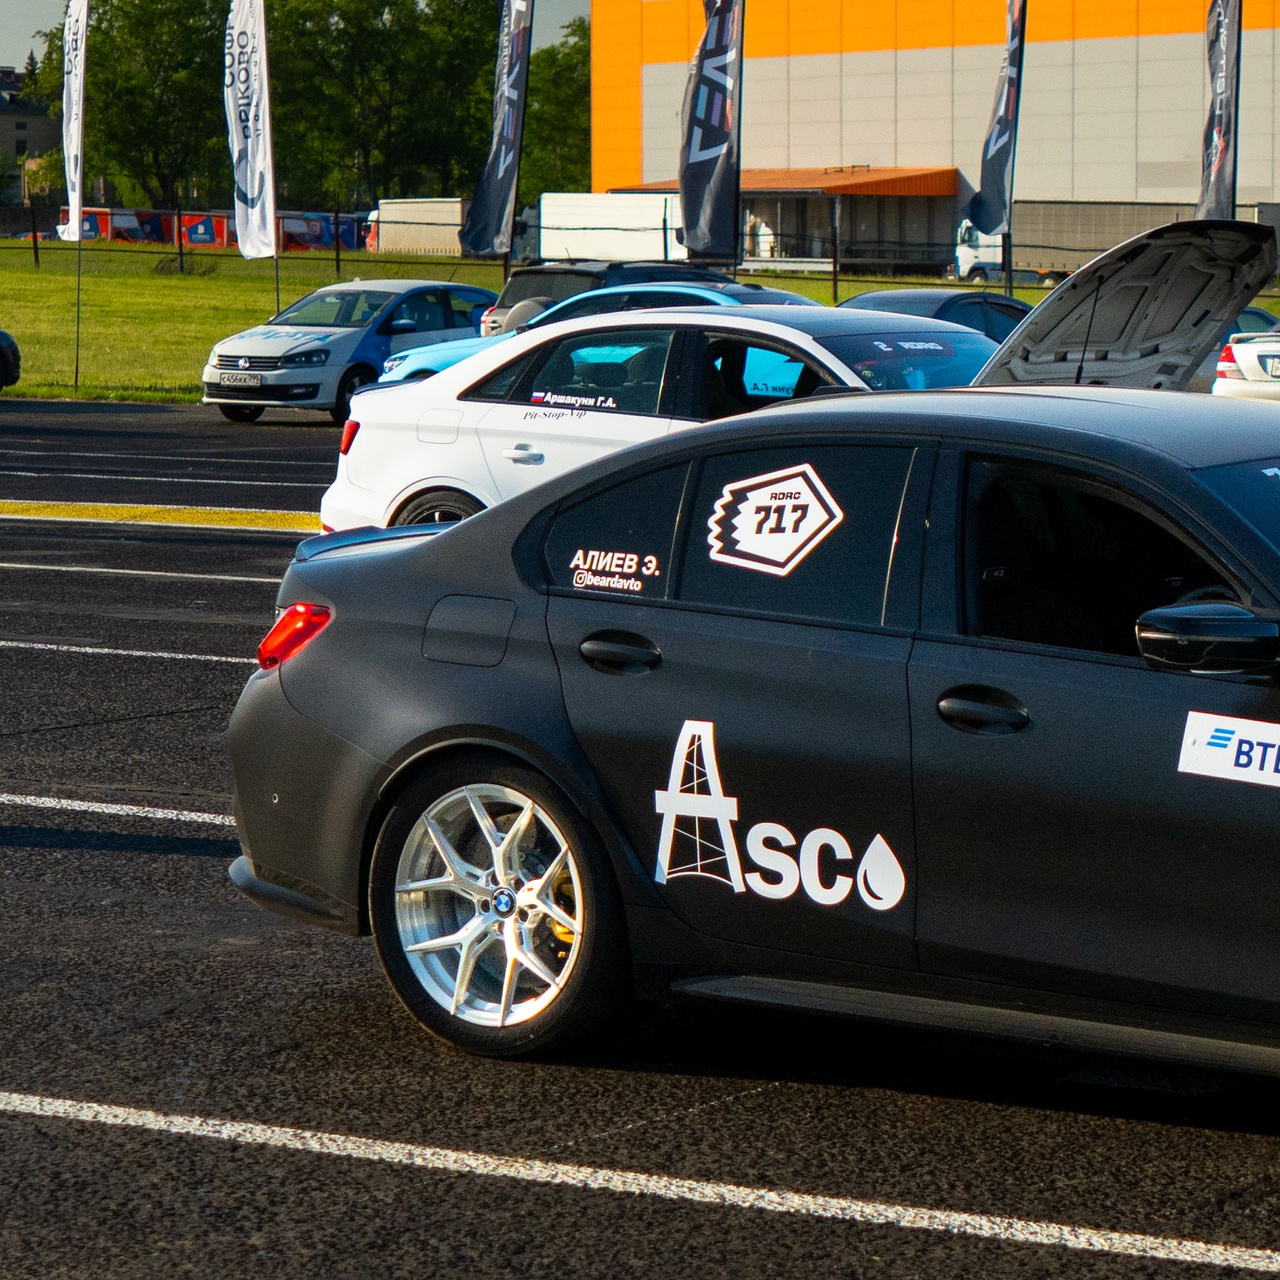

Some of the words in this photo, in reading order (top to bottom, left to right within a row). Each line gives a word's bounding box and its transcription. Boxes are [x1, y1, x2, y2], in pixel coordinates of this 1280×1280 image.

[544, 392, 595, 410] Аршакуни
[596, 396, 617, 408] Г.А.
[770, 491, 802, 501] RDRC
[754, 504, 810, 535] 717
[569, 549, 639, 575] АЛИЕВ
[641, 555, 661, 576] Э.
[586, 571, 642, 592] beardavto
